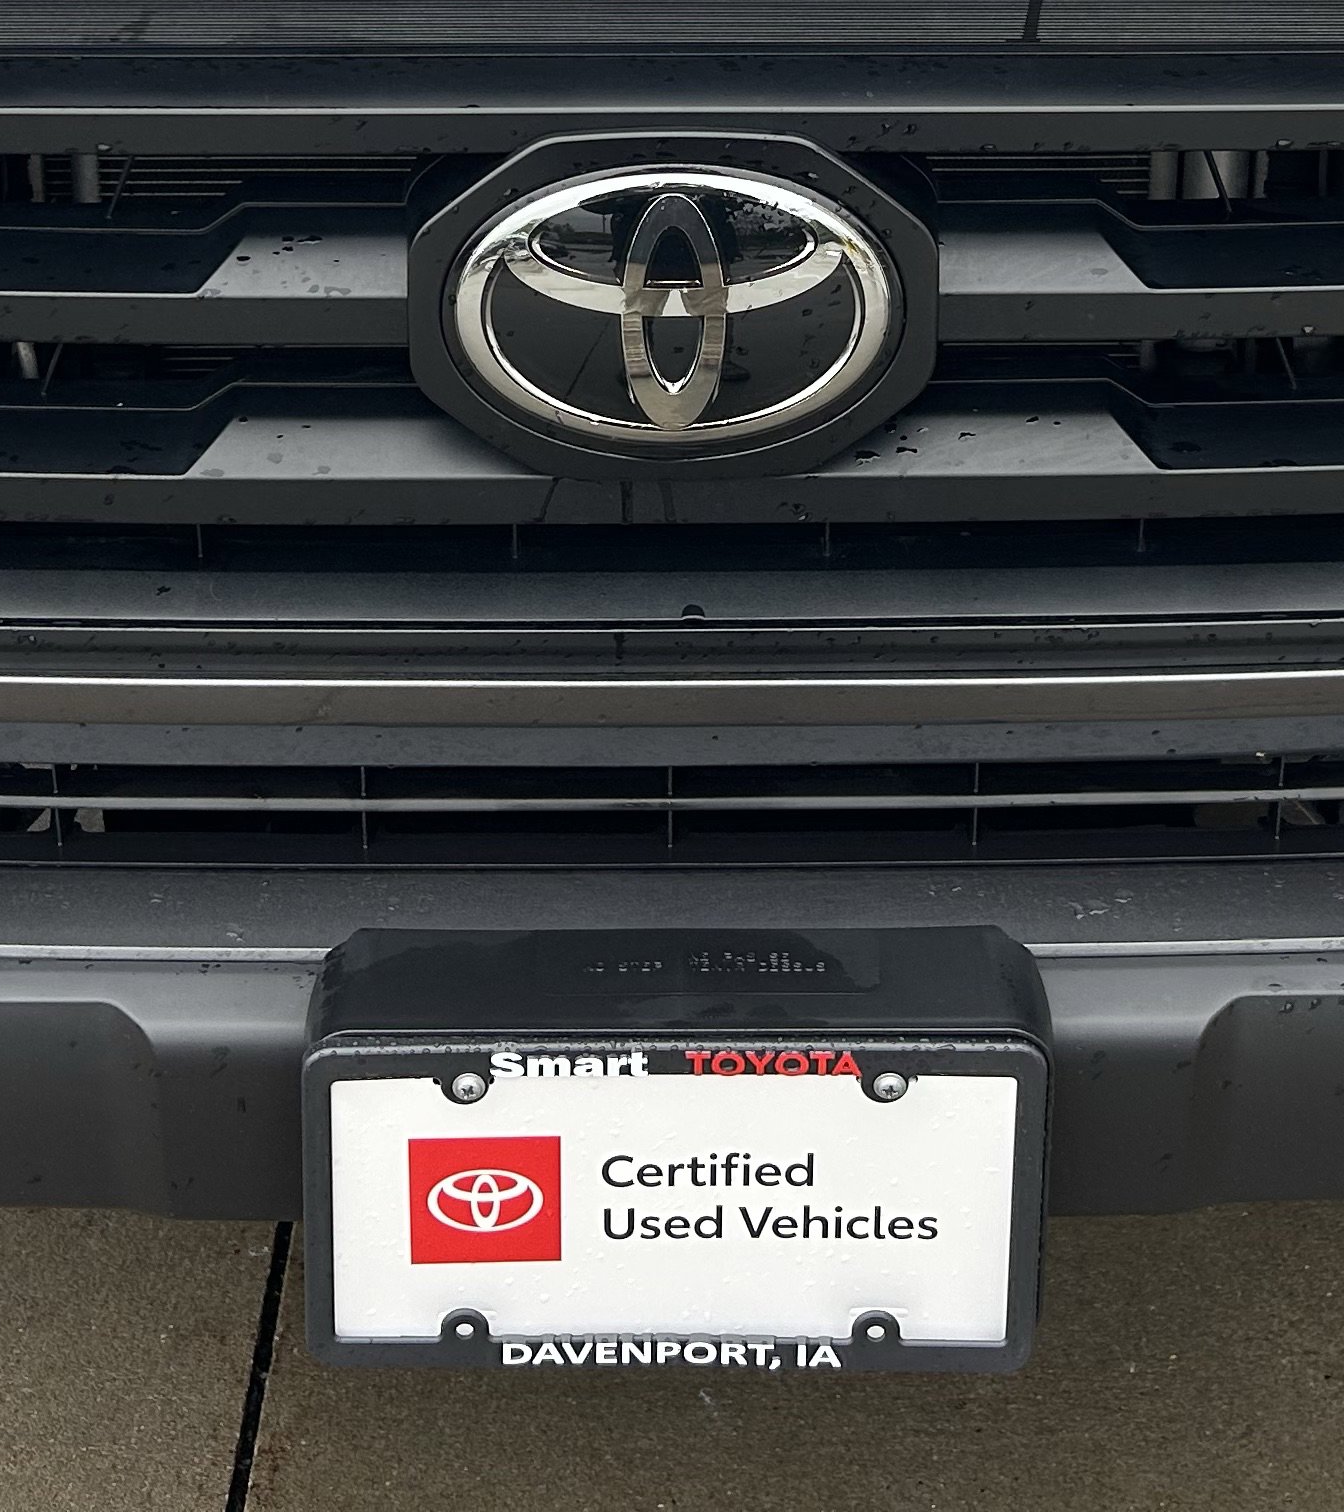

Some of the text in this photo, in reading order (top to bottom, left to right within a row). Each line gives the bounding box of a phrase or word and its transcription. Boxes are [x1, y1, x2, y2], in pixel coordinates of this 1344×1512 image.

[489, 1050, 862, 1079] Smart TOYOTA
[601, 1152, 815, 1188] Certified
[604, 1204, 939, 1240] Used Vehicles
[501, 1340, 842, 1371] DAVENPORT, IA
